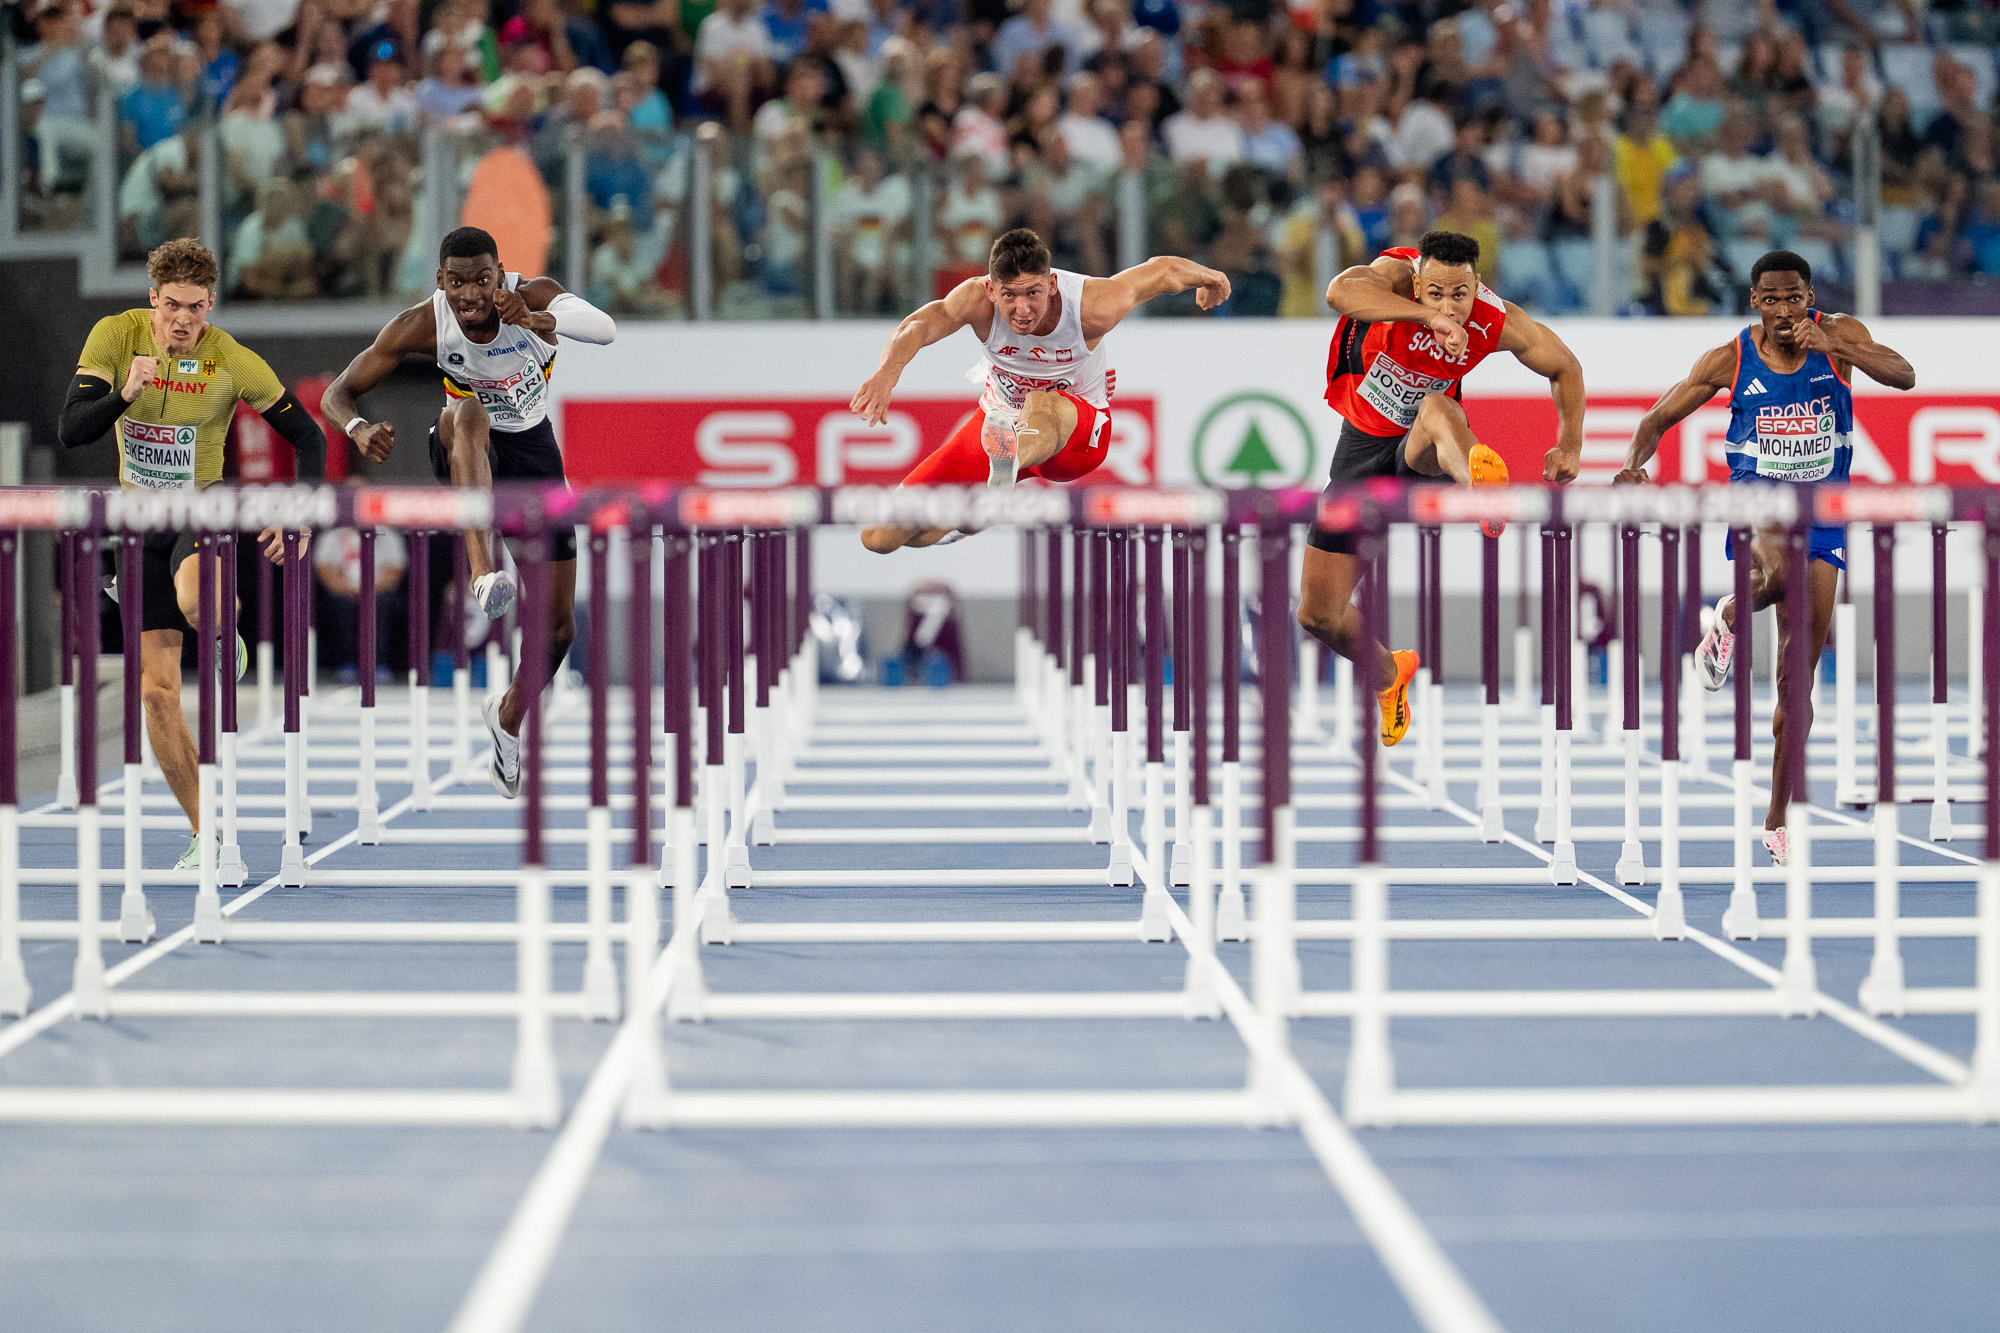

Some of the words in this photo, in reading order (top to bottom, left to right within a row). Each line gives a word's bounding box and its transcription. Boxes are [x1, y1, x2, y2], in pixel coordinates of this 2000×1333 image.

[487, 346, 517, 357] Allianz
[470, 374, 521, 389] SPAR
[1377, 355, 1430, 389] SPAR
[477, 373, 541, 407] BACARI
[1370, 369, 1427, 405] JOSEP
[1367, 391, 1394, 417] ROMA
[1395, 415, 1414, 425] 202
[1759, 395, 1833, 417] FRANCE
[124, 421, 174, 443] SPAR
[1759, 419, 1816, 433] SPAR
[696, 410, 1152, 488] SPR
[1759, 435, 1832, 457] MOHAMED
[151, 471, 175, 479] CLEAN
[1768, 471, 1800, 480] ROMA
[1802, 468, 1825, 479] 2024
[1795, 460, 1819, 469] CLEAN
[131, 473, 156, 489] ROMA
[158, 481, 183, 490] 2024
